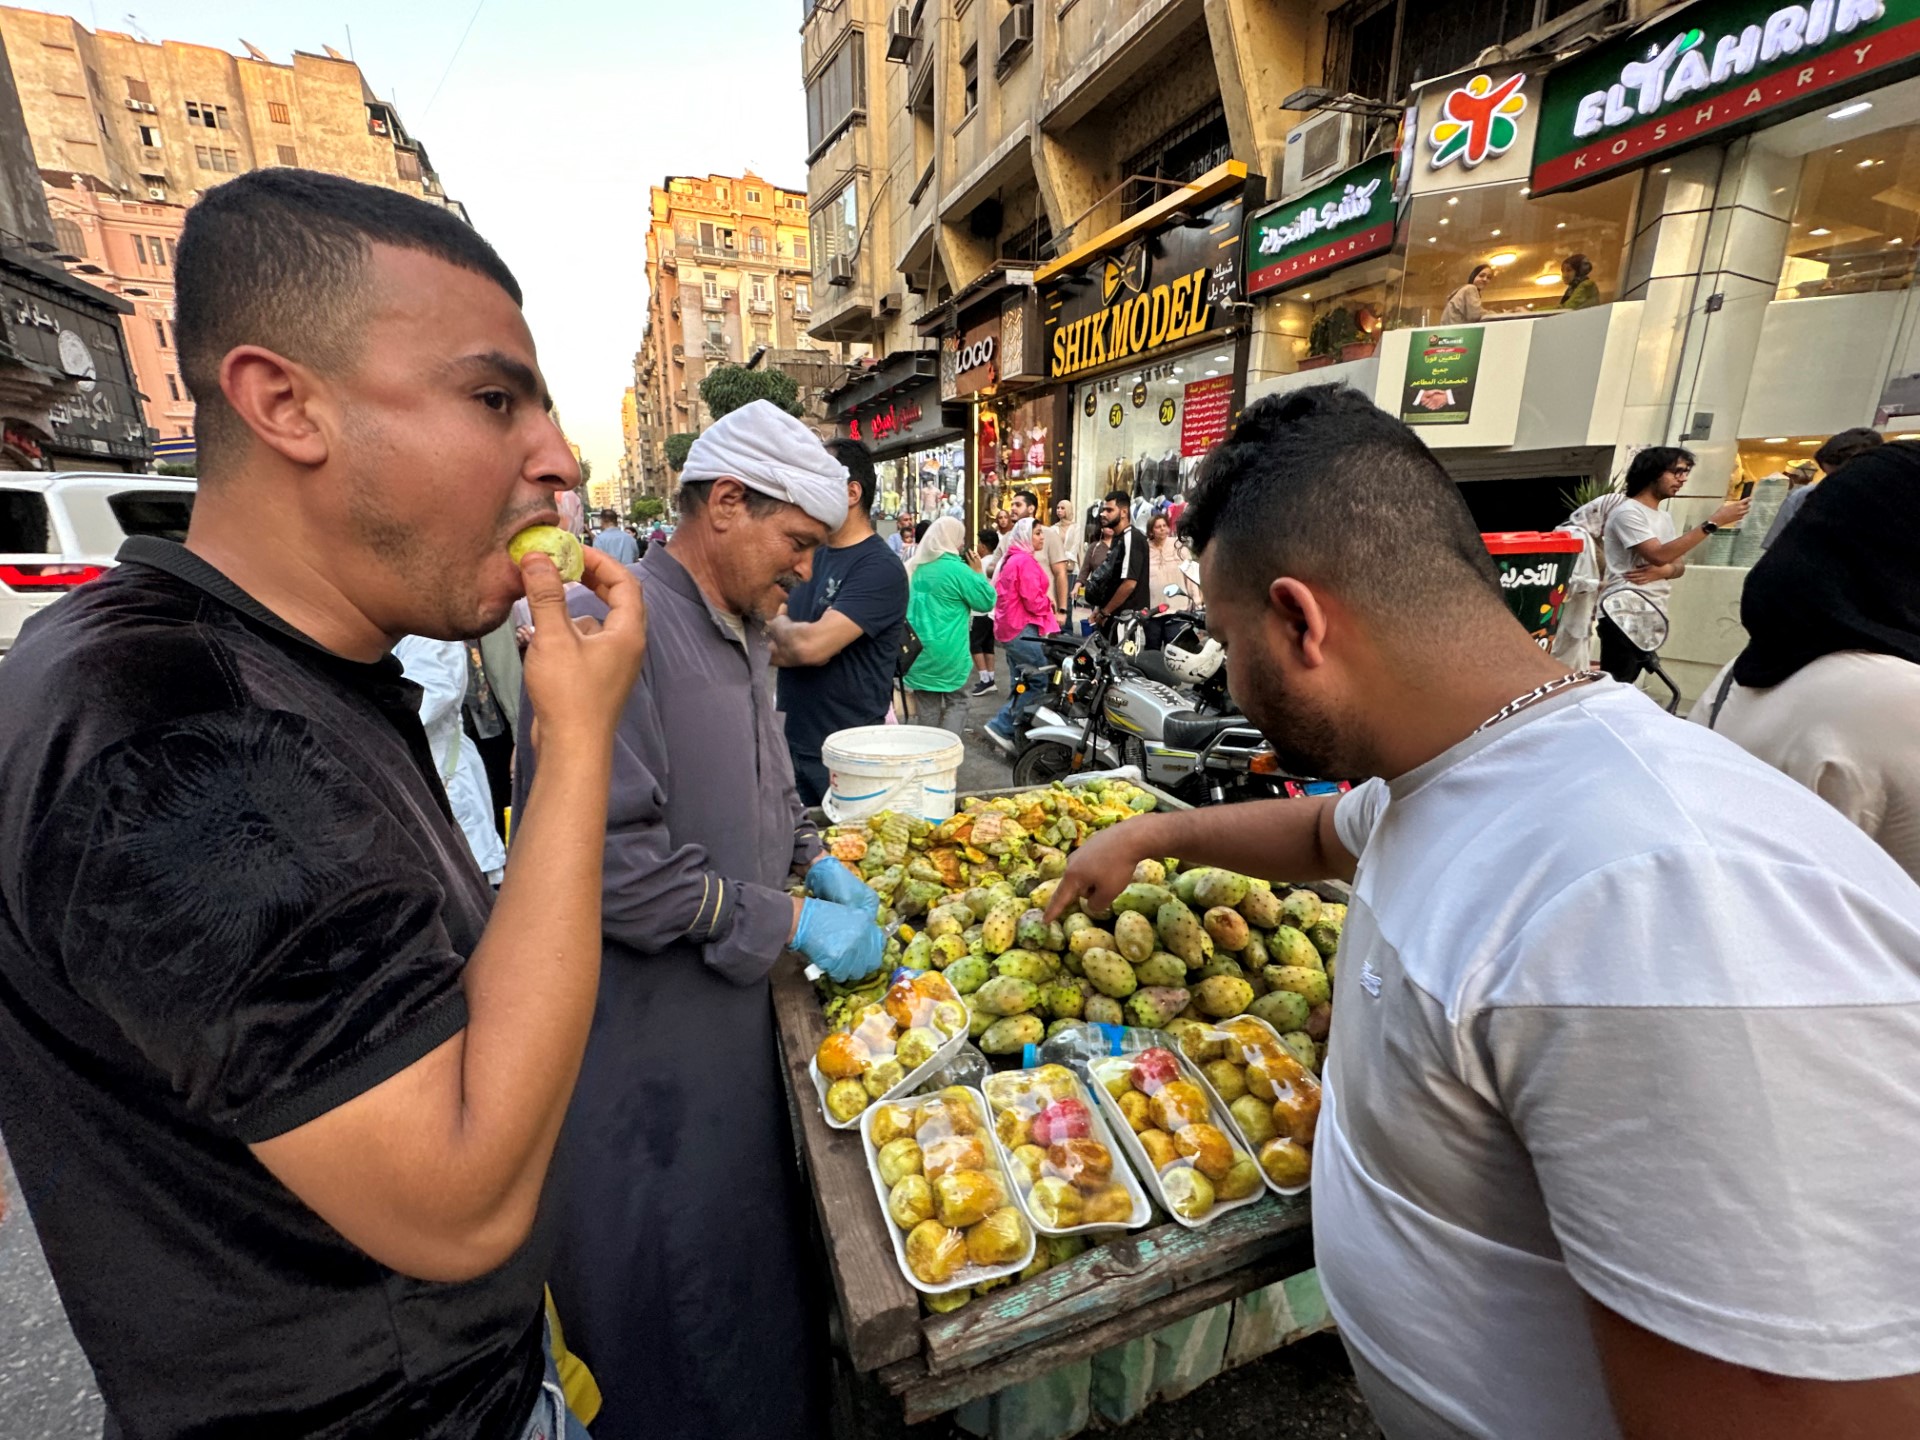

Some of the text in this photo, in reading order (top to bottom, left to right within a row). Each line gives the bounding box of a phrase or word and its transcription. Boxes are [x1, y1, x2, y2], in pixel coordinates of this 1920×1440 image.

[1213, 258, 1233, 280] شيك
[1207, 281, 1236, 301] موديل
[1052, 267, 1211, 378] SHIK MODEL
[955, 336, 993, 374] LOGO
[1110, 410, 1121, 426] 50
[1161, 405, 1173, 424] 20
